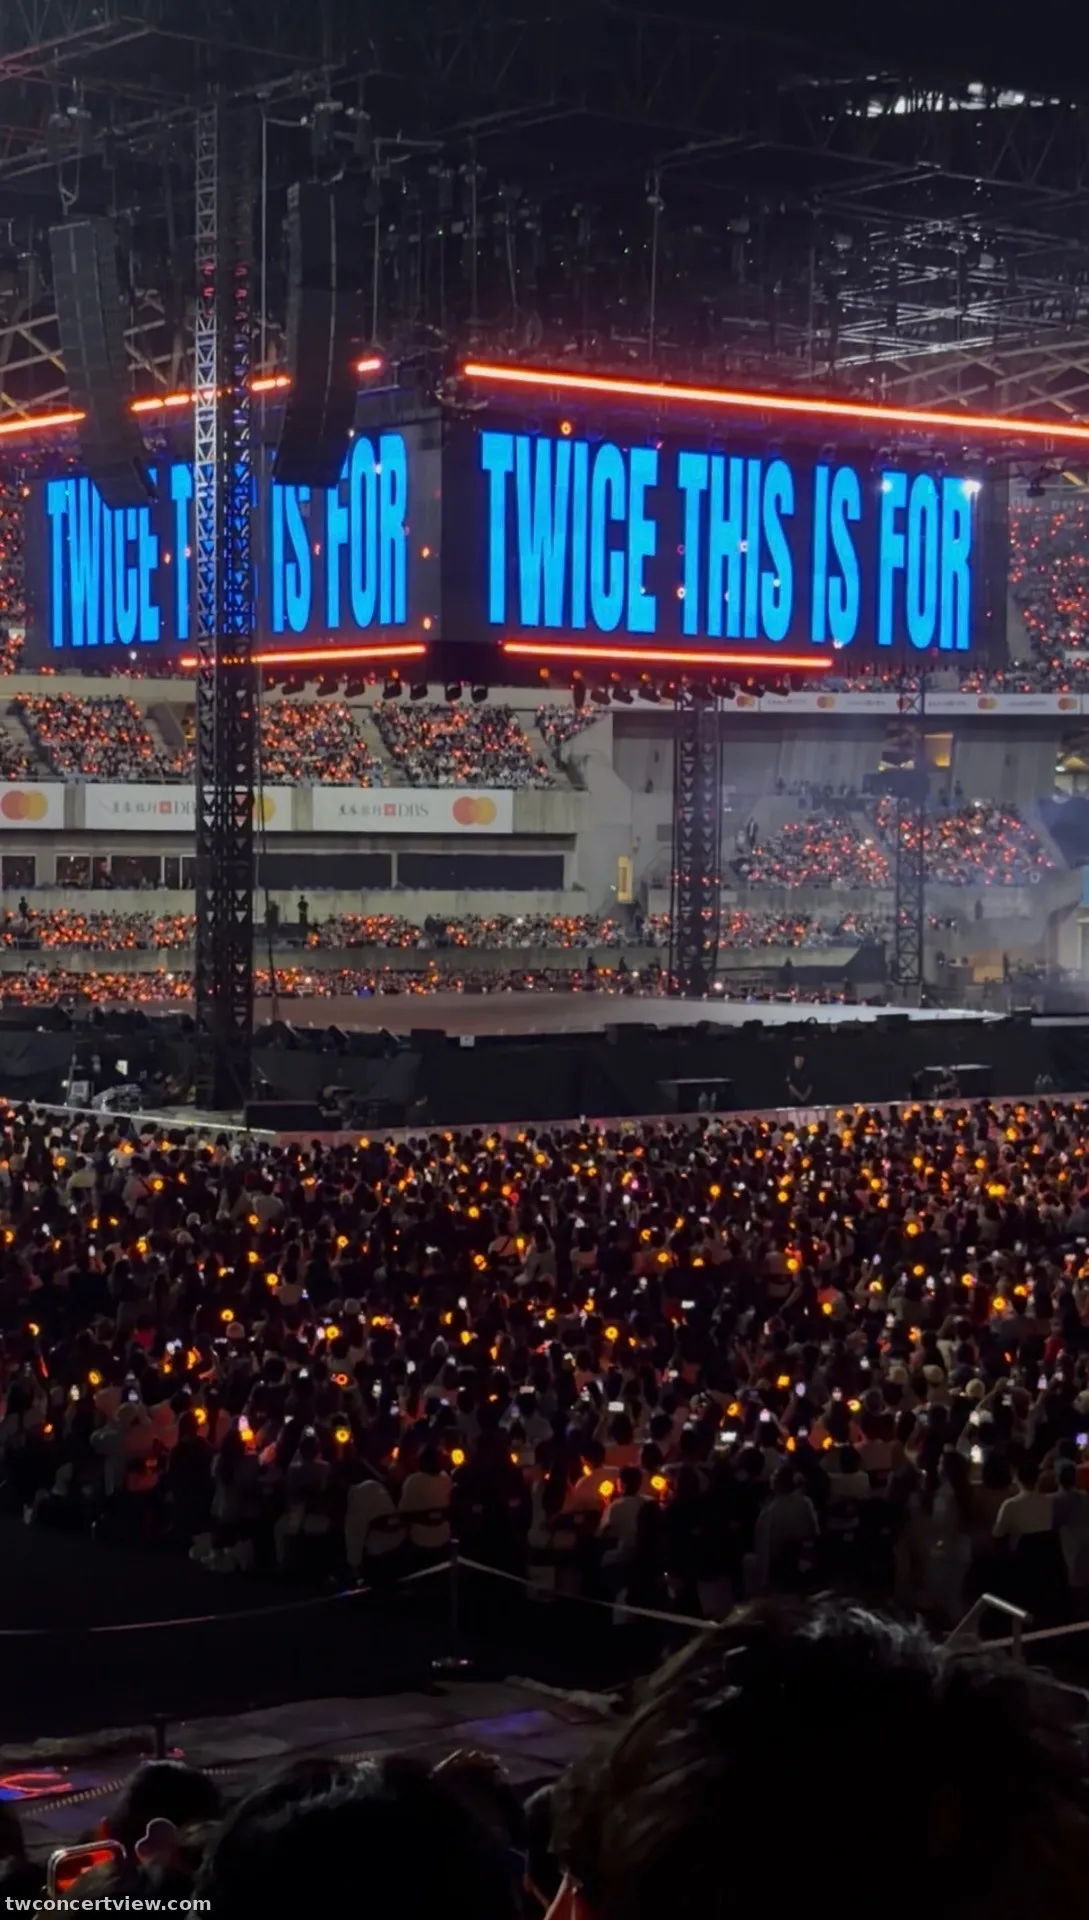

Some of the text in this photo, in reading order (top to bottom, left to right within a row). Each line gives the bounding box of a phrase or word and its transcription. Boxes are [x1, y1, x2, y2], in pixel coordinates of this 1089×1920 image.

[327, 434, 408, 628] FOR
[481, 432, 657, 633] TWICE
[679, 451, 794, 641] THIS
[812, 465, 861, 645] IS
[879, 472, 977, 650] FOR
